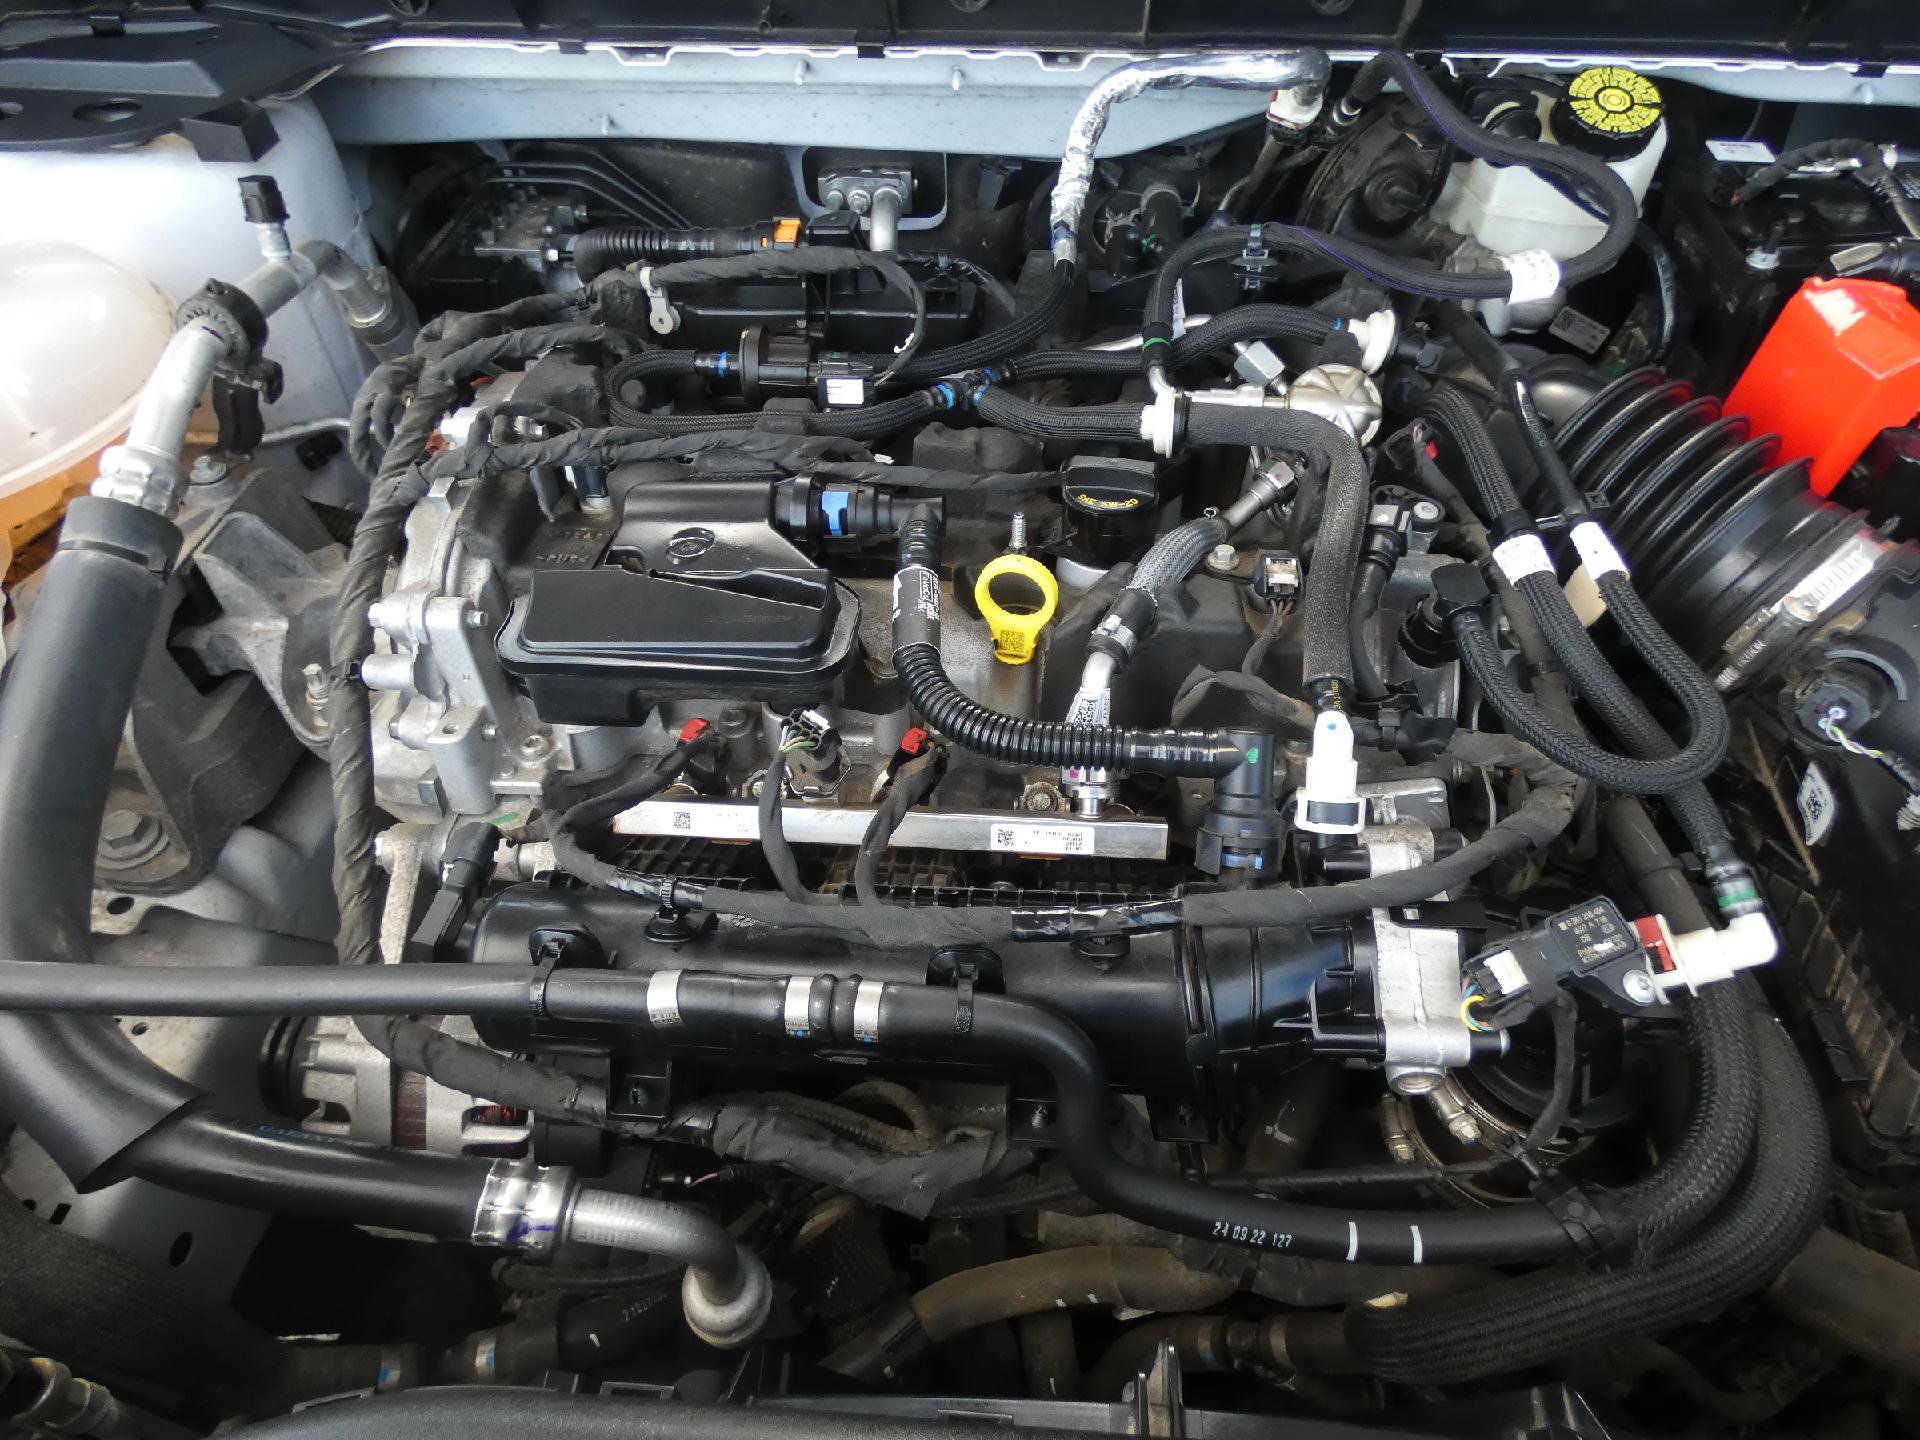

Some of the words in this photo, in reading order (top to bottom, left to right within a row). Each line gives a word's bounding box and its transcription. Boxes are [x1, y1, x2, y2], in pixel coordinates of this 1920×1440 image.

[1233, 1225, 1248, 1241] 09
[1250, 1229, 1266, 1244] 22
[1272, 1232, 1293, 1248] 127
